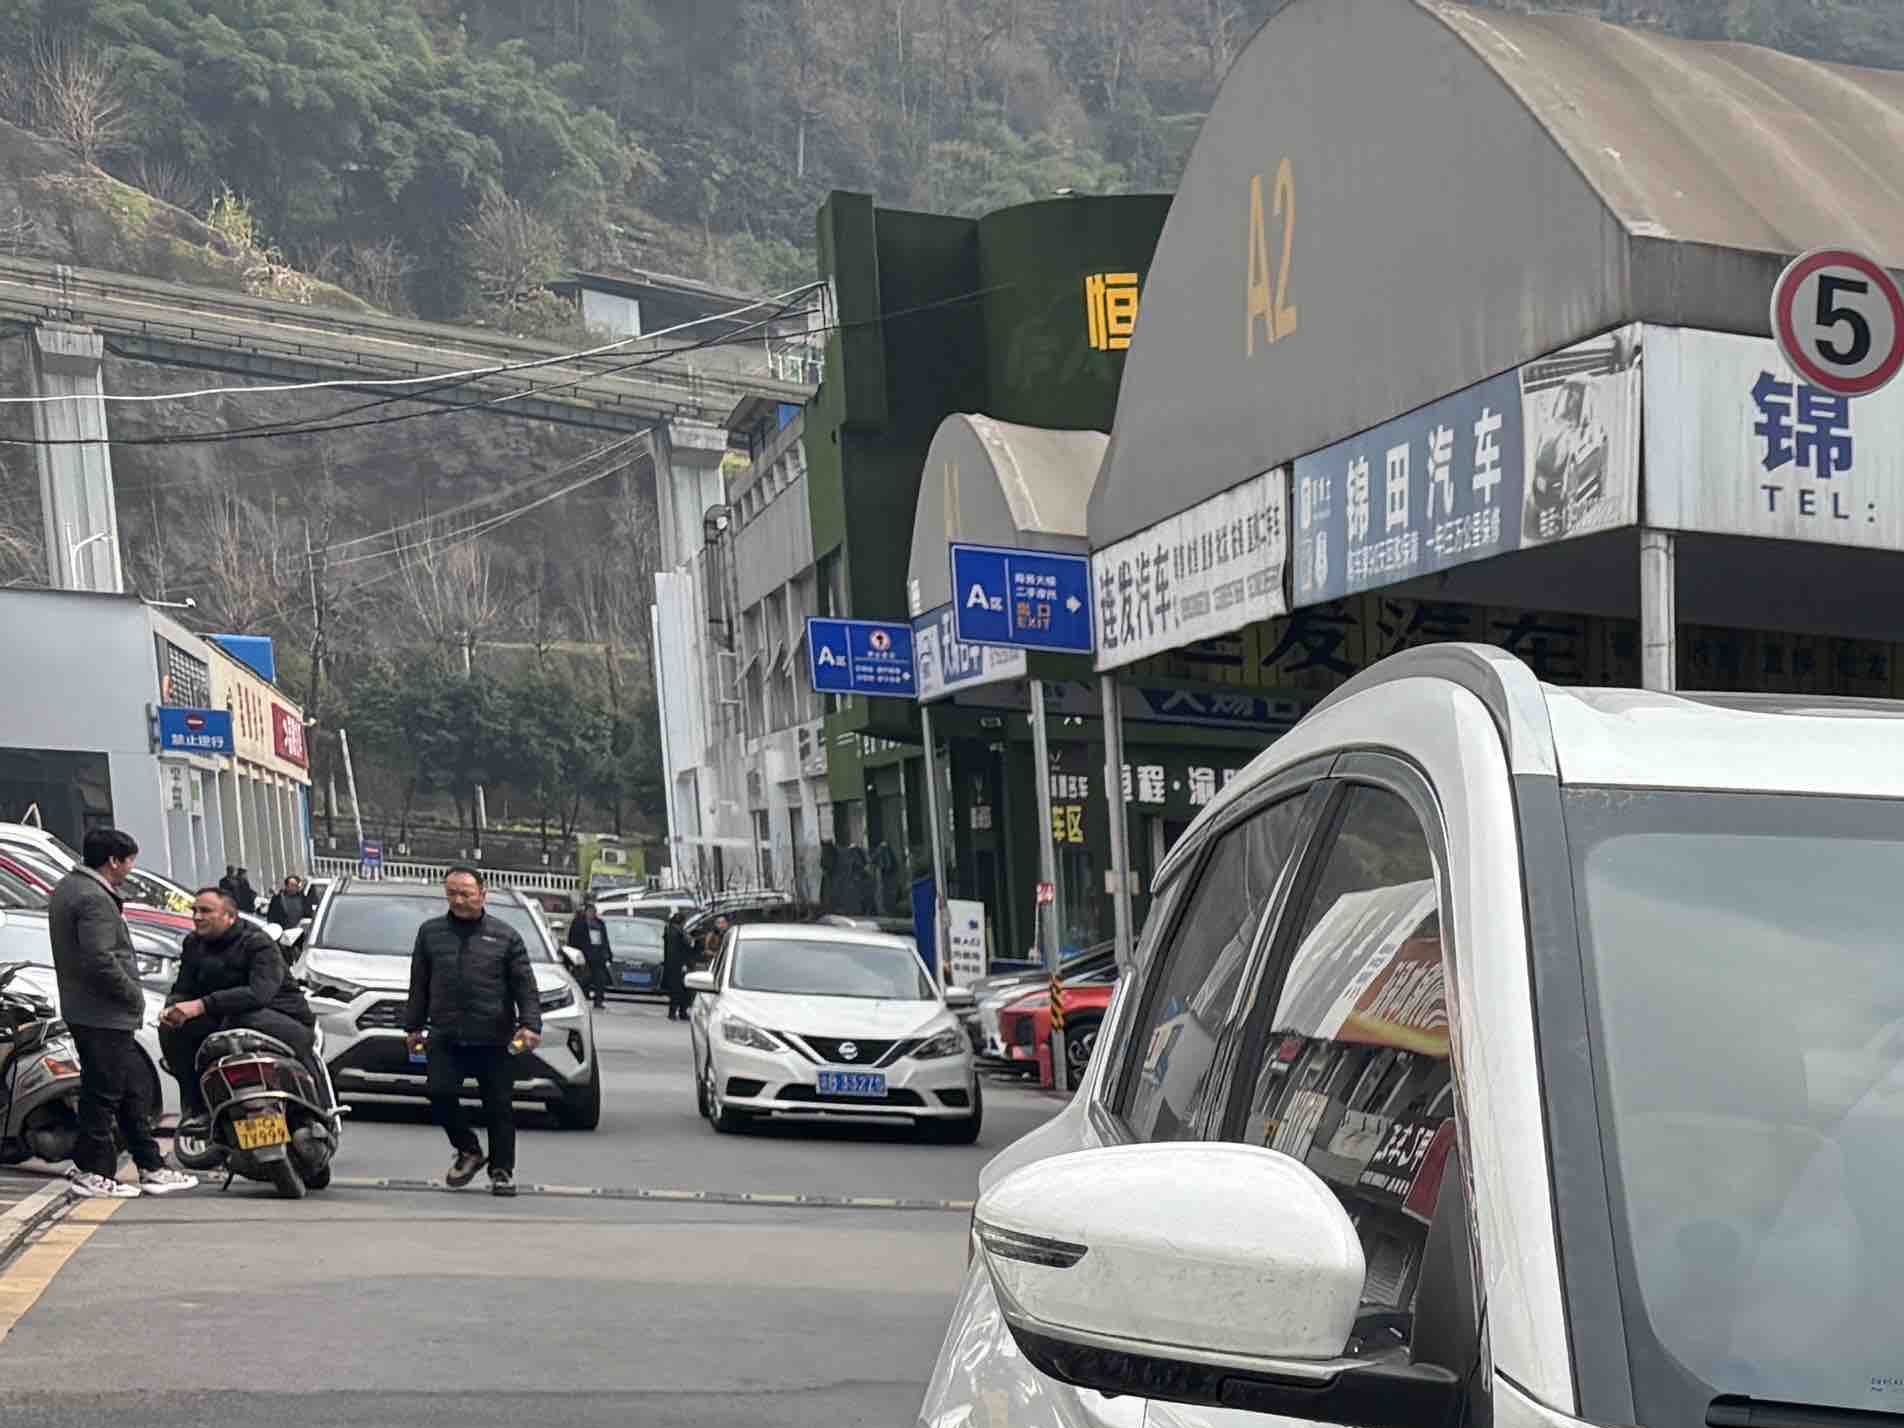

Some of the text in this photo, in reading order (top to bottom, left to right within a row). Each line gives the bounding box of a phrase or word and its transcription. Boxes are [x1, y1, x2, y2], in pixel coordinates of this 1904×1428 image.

[1246, 157, 1298, 358] A2
[1815, 273, 1872, 366] 5
[1760, 483, 1877, 524] TEL:
